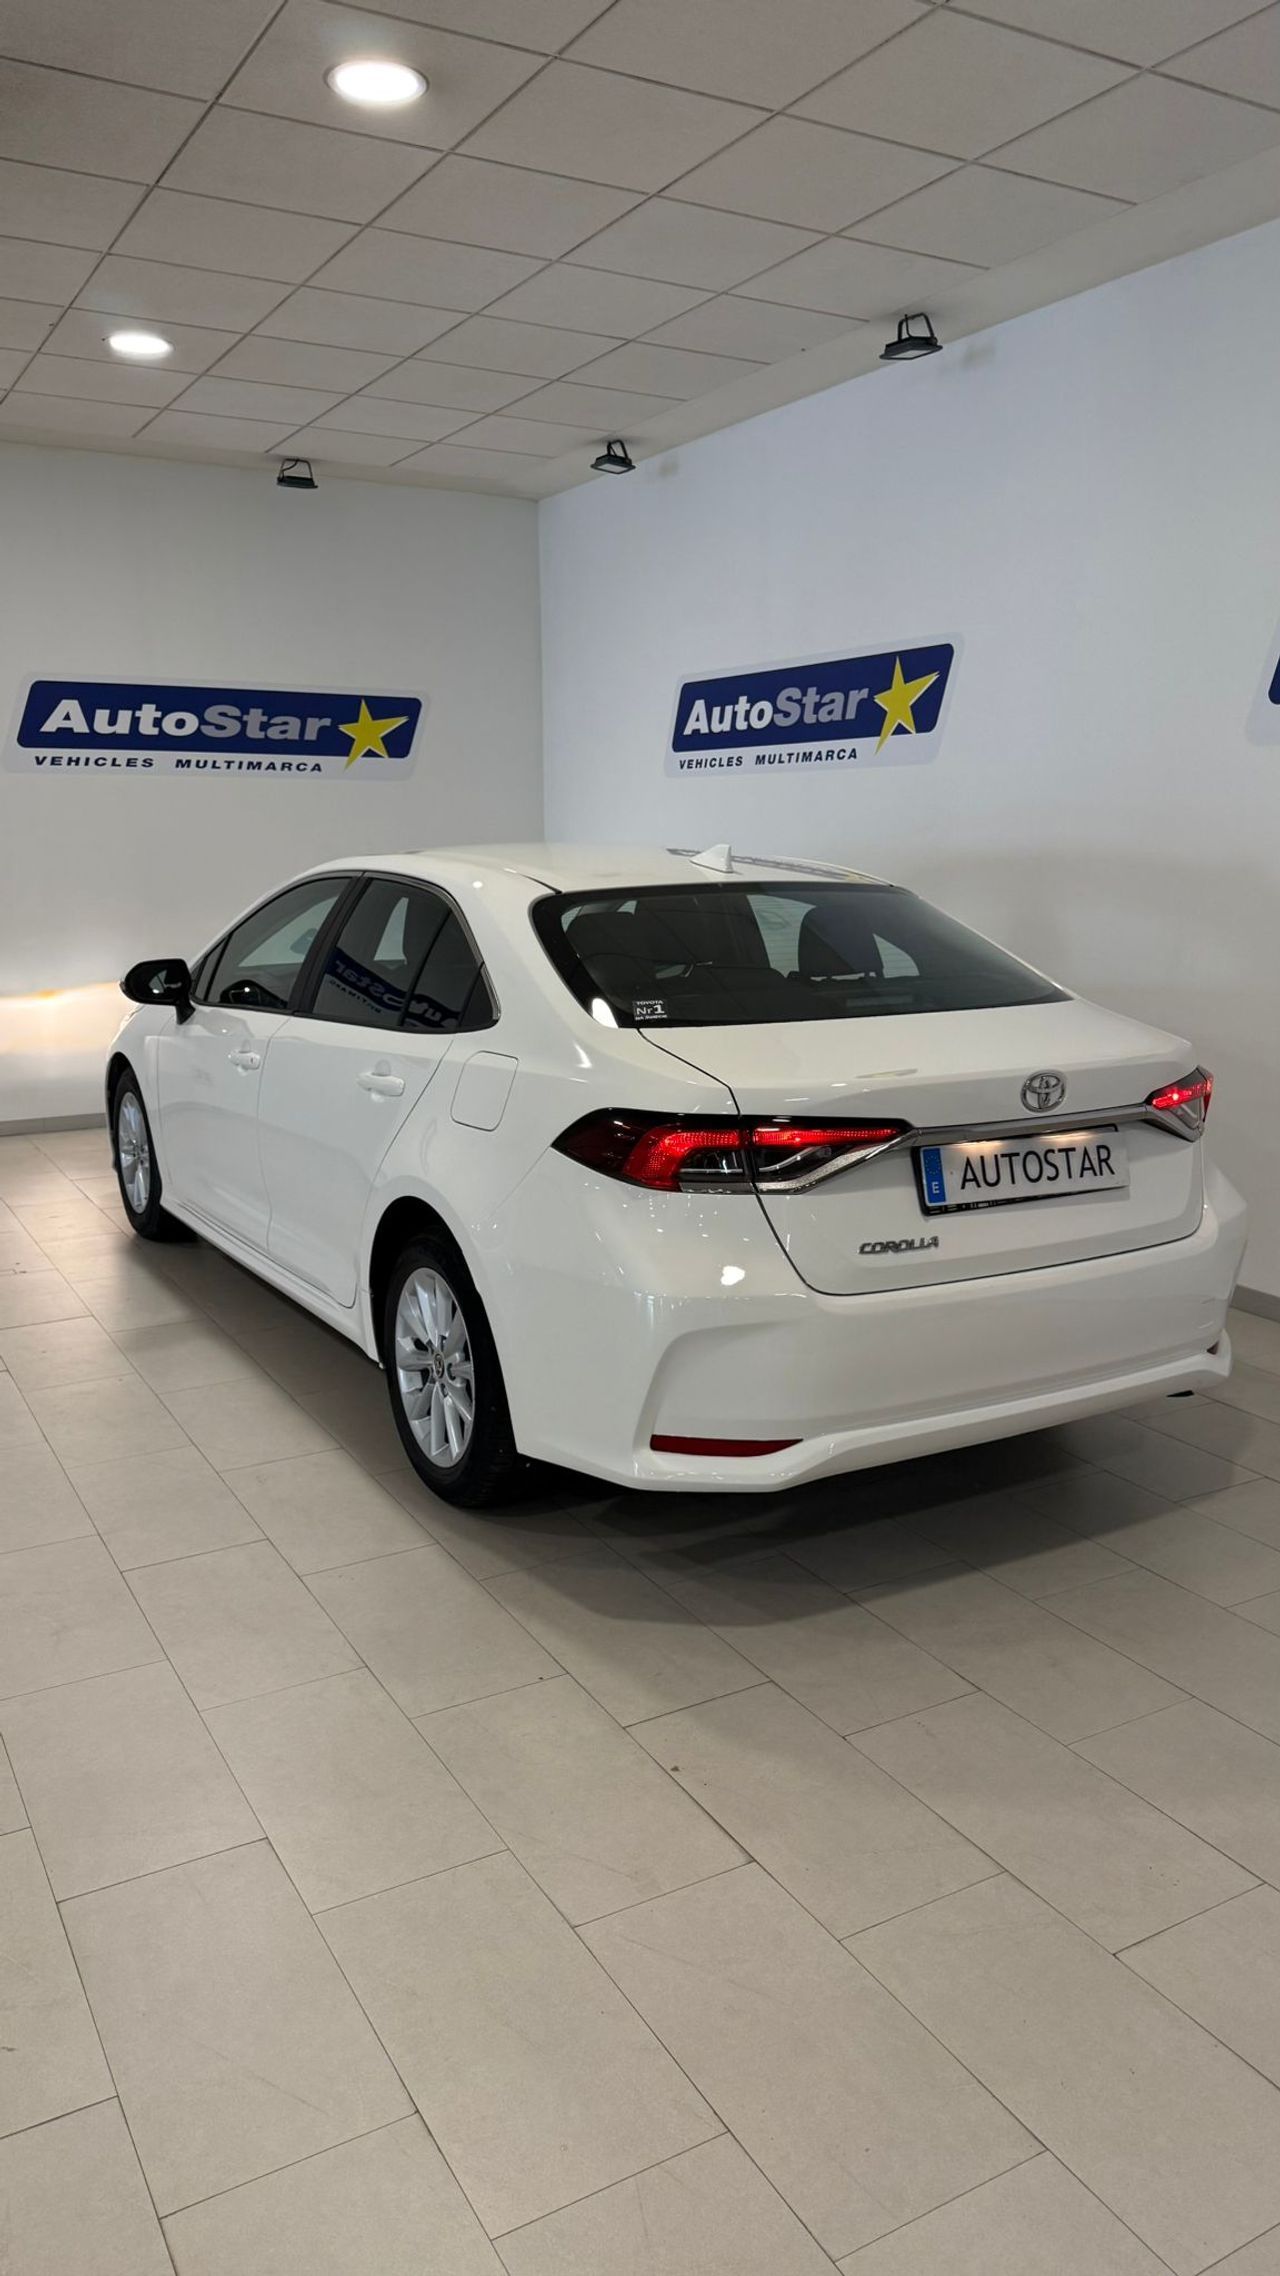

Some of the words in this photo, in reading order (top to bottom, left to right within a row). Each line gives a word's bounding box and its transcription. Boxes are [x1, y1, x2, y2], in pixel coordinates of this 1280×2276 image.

[40, 698, 331, 741] AutoStar
[683, 687, 869, 735] AutoStar
[35, 755, 155, 769] VEHICLES
[175, 758, 323, 773] MULTIMARCA
[679, 756, 744, 770] VEHICLES
[755, 748, 858, 766] MULTIMARCA
[960, 1144, 1116, 1190] AUTOSTAR
[932, 1182, 940, 1194] E
[858, 1236, 939, 1254] COROLLA
